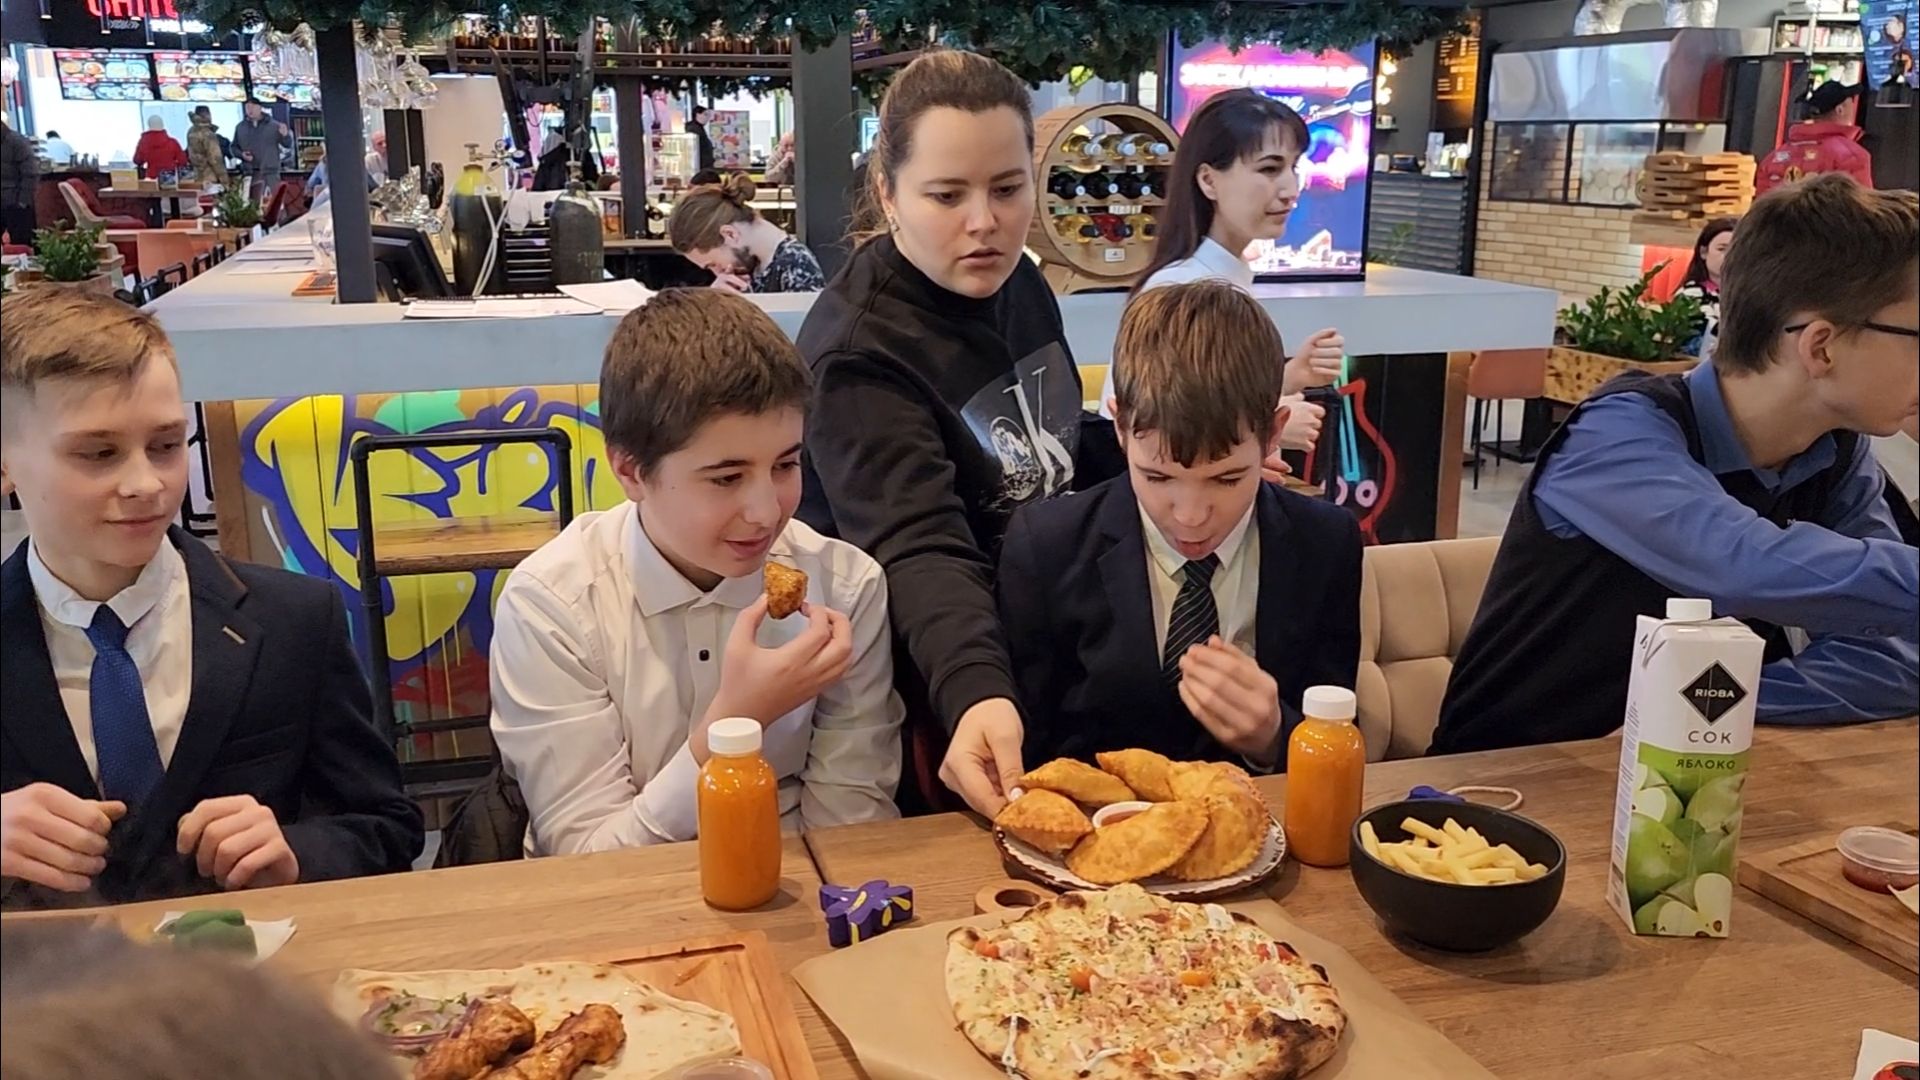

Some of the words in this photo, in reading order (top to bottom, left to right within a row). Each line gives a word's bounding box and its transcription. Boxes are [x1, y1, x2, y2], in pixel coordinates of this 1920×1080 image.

[1694, 688, 1735, 699] RIOBA
[1688, 730, 1732, 744] СОК
[1676, 758, 1736, 770] ЯБЛОКО
